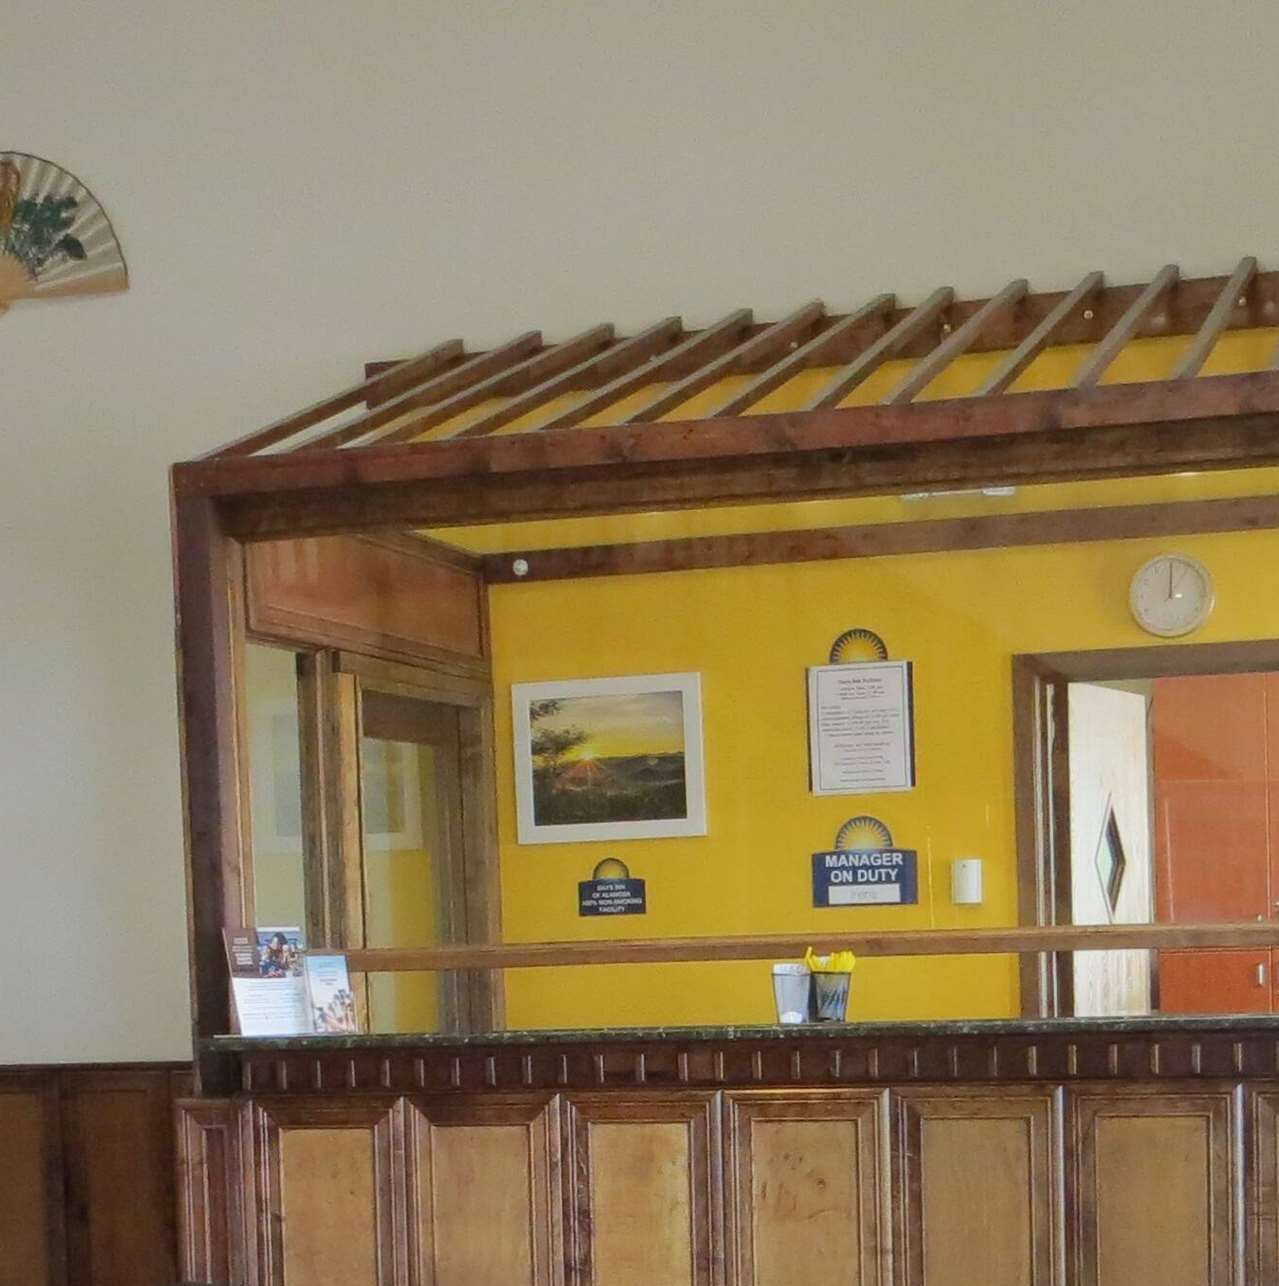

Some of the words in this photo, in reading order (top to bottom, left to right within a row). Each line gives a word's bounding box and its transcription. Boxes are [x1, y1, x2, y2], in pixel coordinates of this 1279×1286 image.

[825, 852, 904, 868] MANAGER
[830, 870, 853, 883] ON
[857, 868, 899, 883] DUTY
